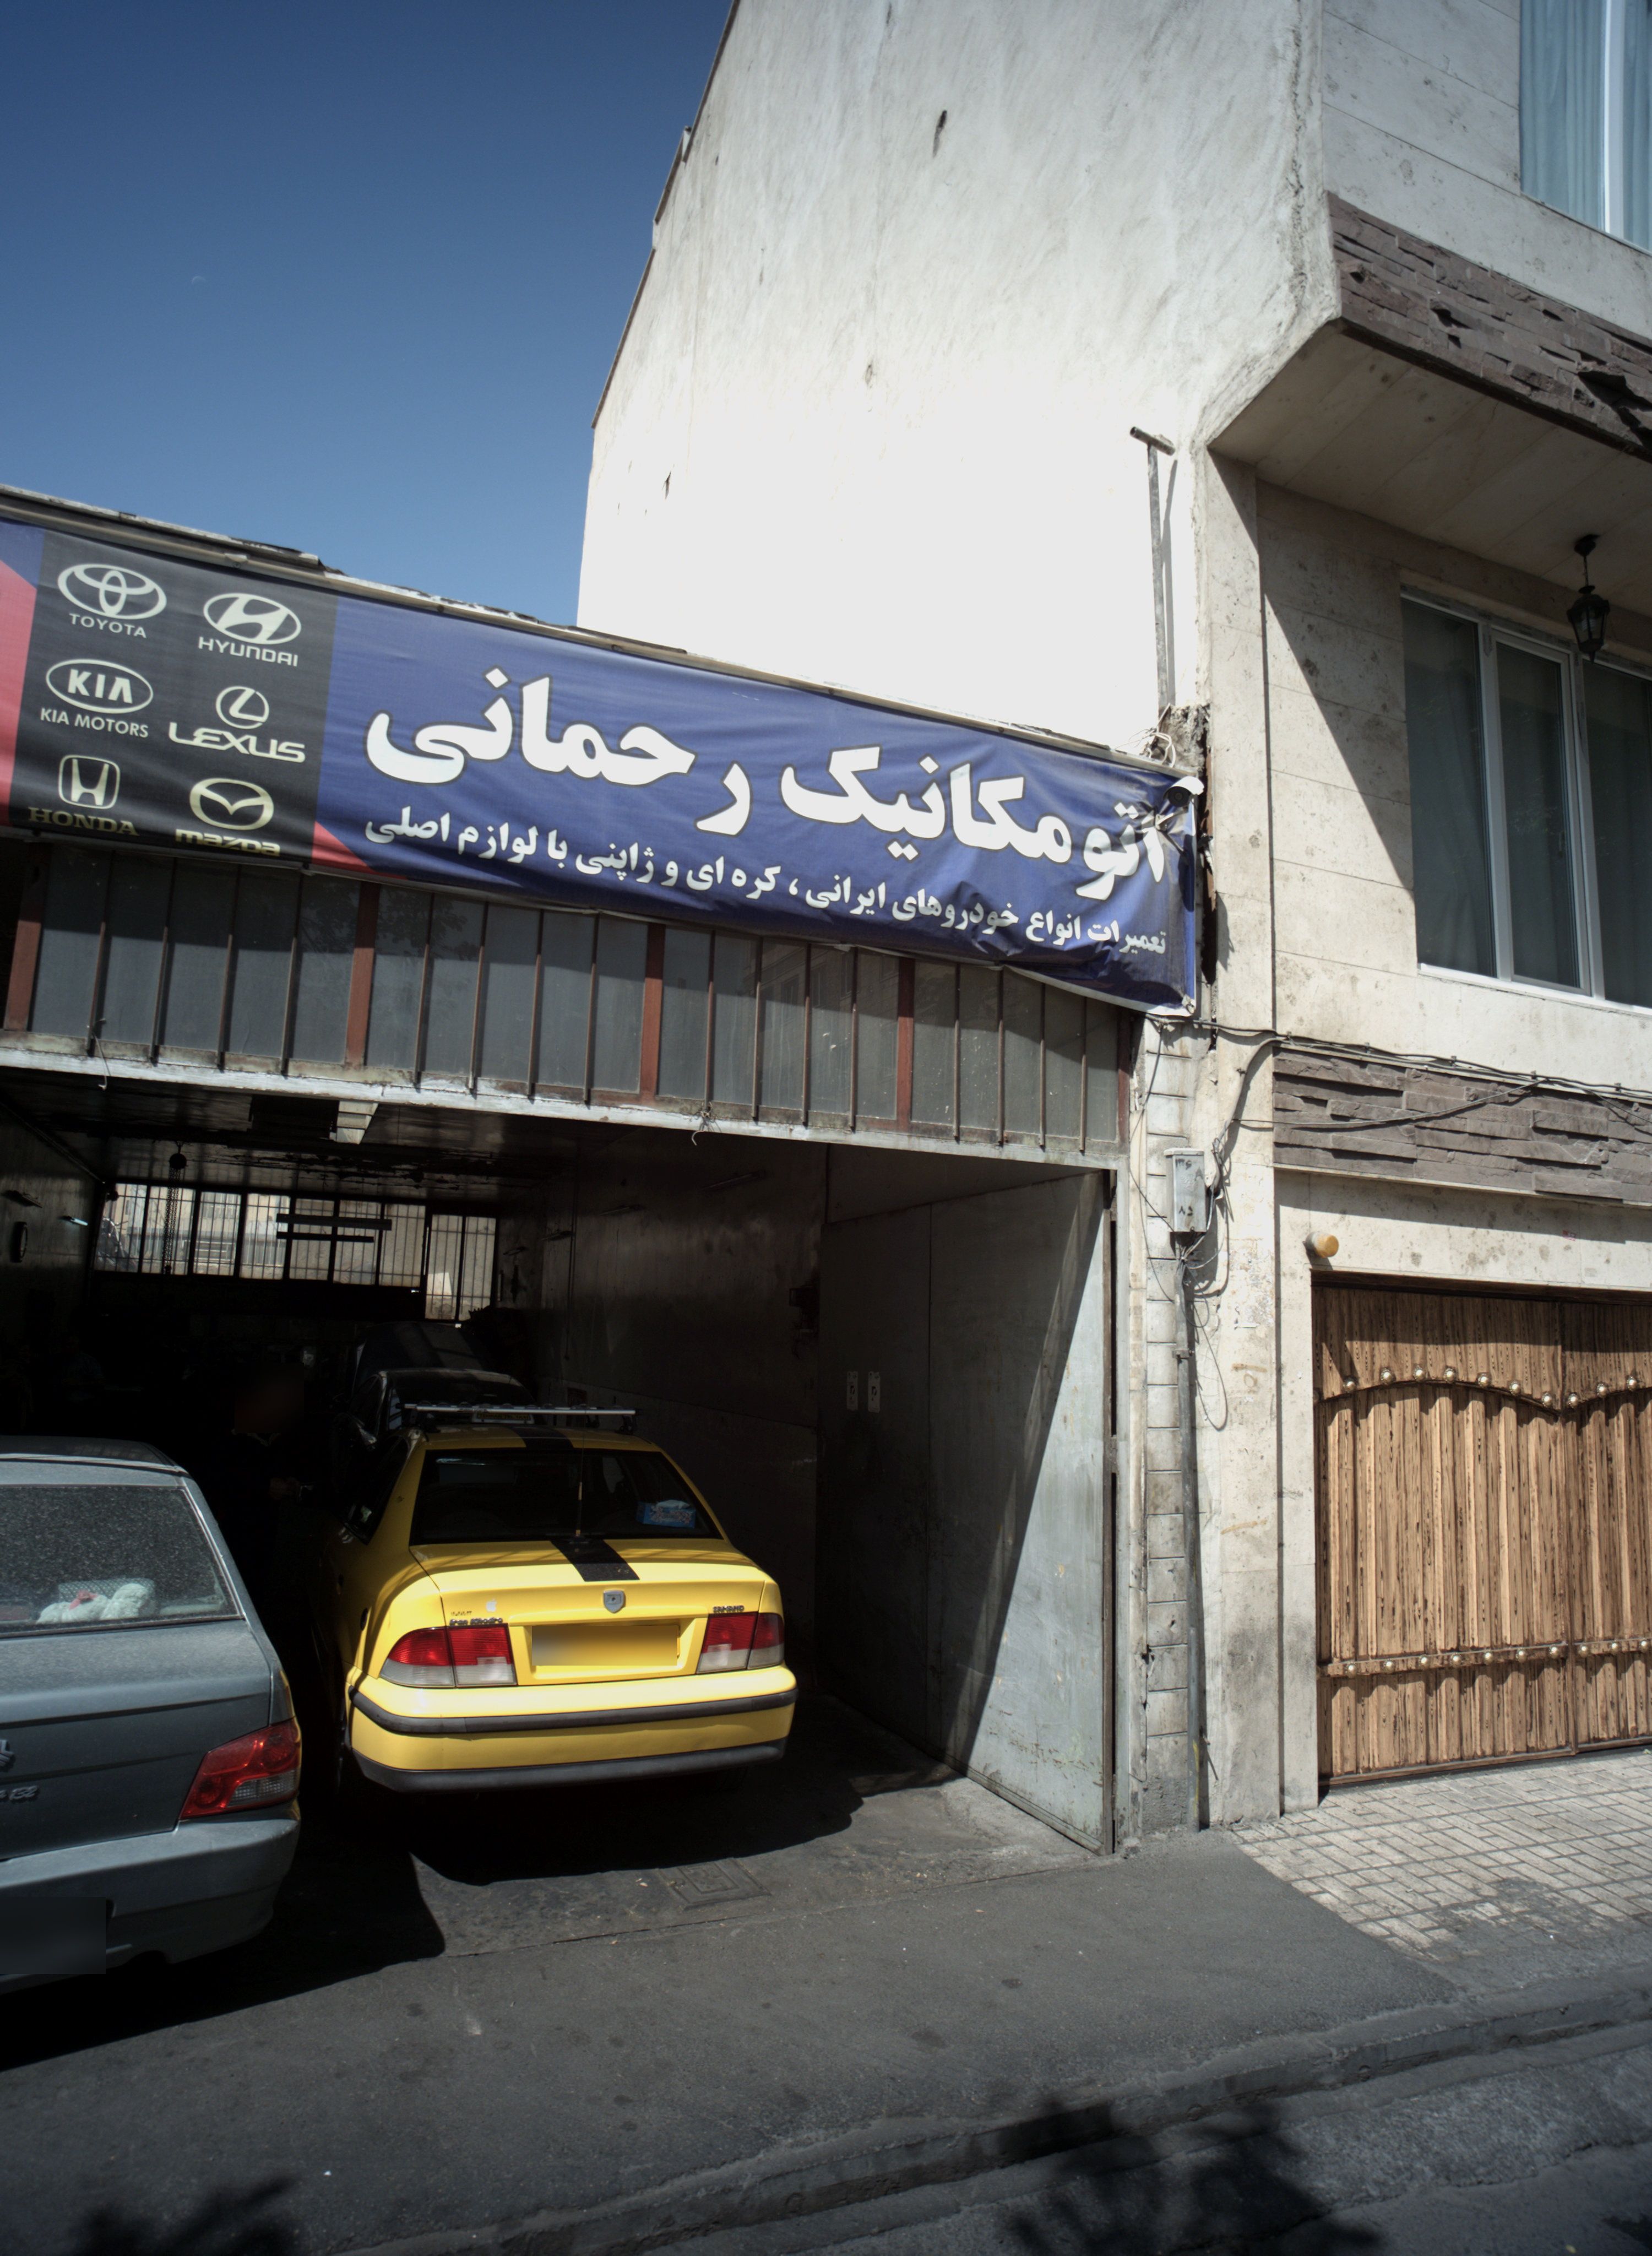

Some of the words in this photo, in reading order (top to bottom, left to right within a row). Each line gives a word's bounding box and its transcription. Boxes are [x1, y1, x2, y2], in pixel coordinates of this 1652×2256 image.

[69, 613, 147, 638] TOYOTA
[198, 636, 298, 667] HYUNDAI
[68, 669, 133, 704] KIA
[40, 707, 69, 726] KIA
[74, 714, 149, 739] MOTORS
[169, 722, 306, 763] LEXUS
[367, 665, 751, 837] رحمانی
[28, 807, 140, 837] HONDA
[365, 805, 451, 844] اصلی
[458, 821, 539, 864] لوازم
[546, 829, 568, 869] با
[575, 841, 655, 884] ژاپنی
[661, 860, 678, 887] و
[805, 874, 887, 915] ایرانی
[892, 888, 1020, 935] خودروهای
[1025, 909, 1082, 946] انواع
[1086, 920, 1166, 955] تعمیرات
